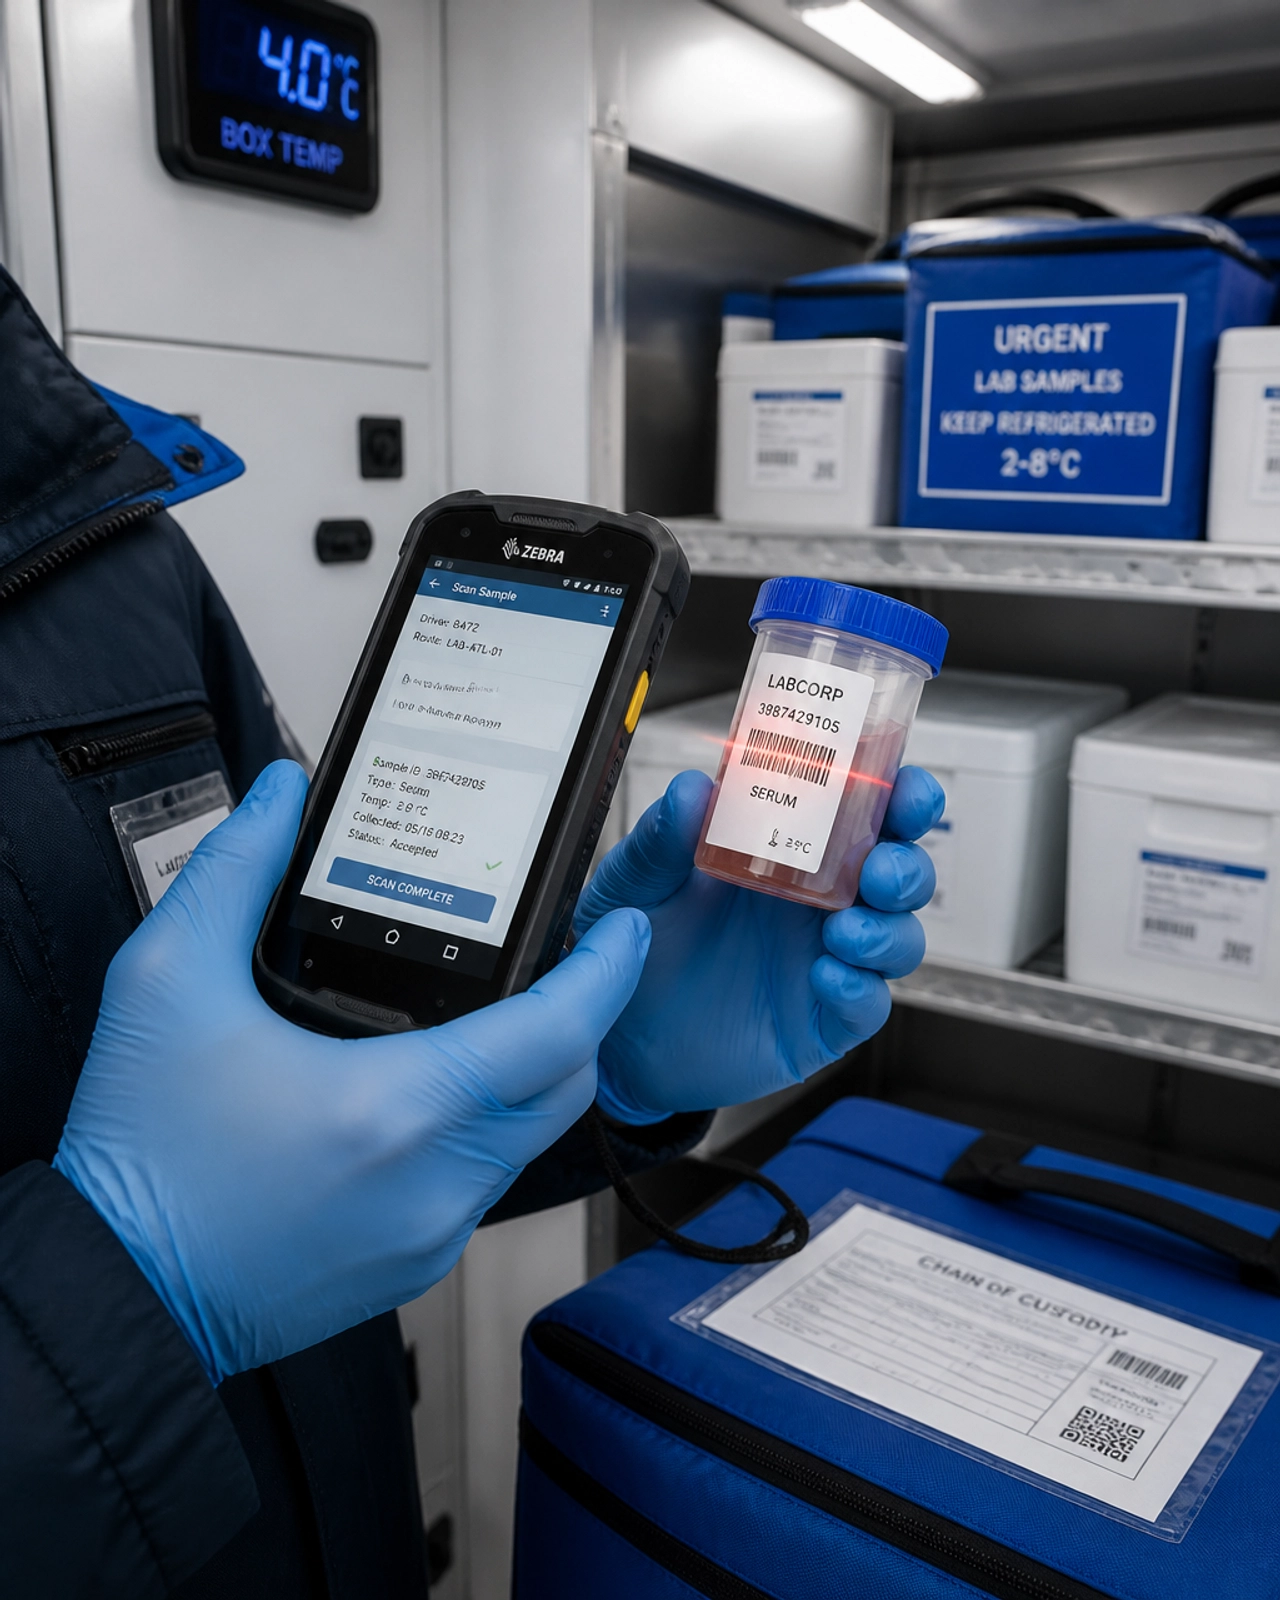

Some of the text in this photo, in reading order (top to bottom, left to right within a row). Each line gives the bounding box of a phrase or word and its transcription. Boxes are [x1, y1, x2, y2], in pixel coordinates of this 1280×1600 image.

[220, 115, 344, 175] BOX TEMP
[994, 322, 1111, 354] URGENT
[974, 368, 1124, 394] LAB SAMPLES
[939, 410, 1157, 436] KEEP REFRIGERATED
[1000, 447, 1082, 479] 2-8°C
[521, 545, 565, 564] ZEBRA
[452, 582, 518, 603] Scan Sample
[767, 673, 844, 703] LABCORP
[749, 785, 798, 809] SERUM
[366, 874, 455, 906] SCAN COMPLETE
[917, 1255, 985, 1289] CHAIN
[986, 1281, 1016, 1298] OF
